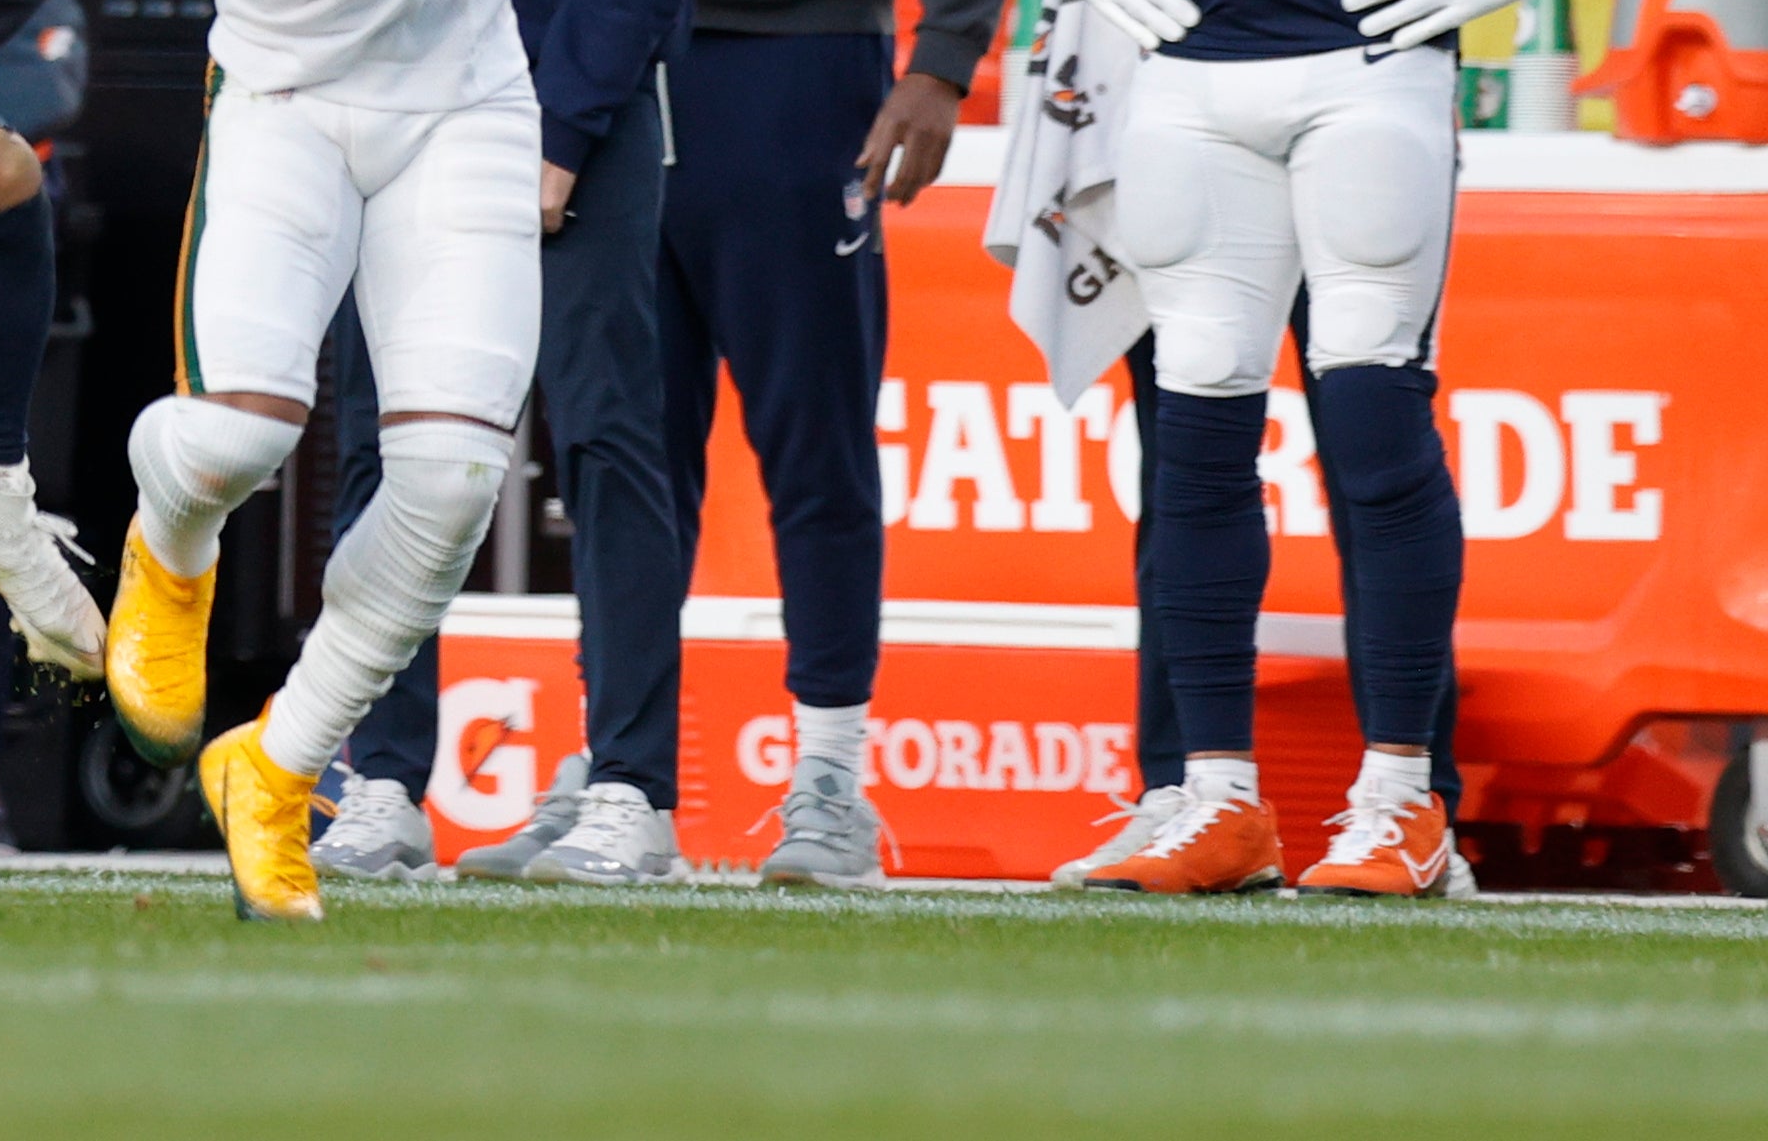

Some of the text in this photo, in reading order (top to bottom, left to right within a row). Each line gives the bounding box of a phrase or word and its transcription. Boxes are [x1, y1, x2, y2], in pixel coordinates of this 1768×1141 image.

[875, 382, 1662, 541] ATRDE
[427, 677, 542, 831] G
[736, 715, 1133, 793] GTORADE
